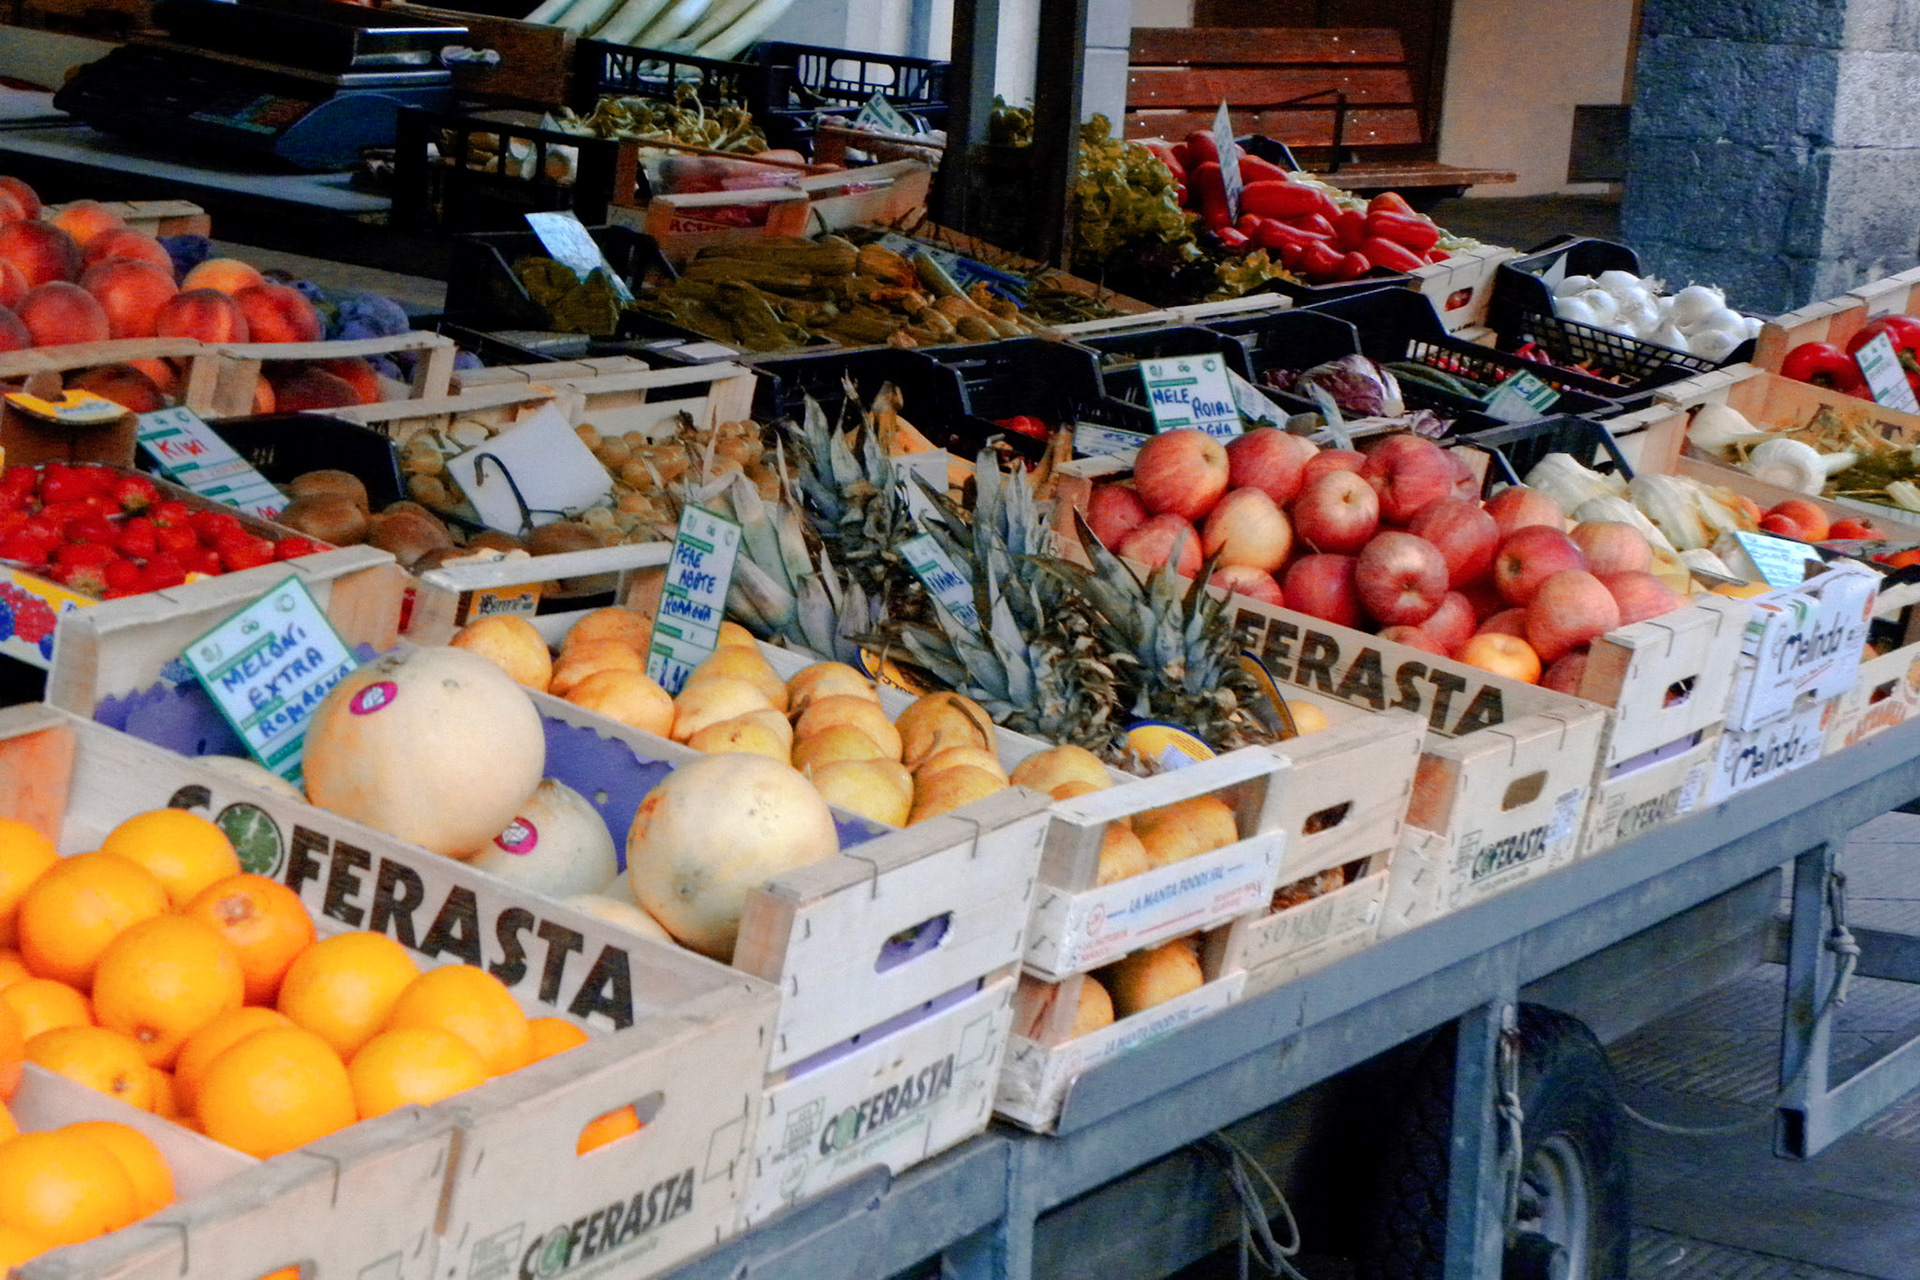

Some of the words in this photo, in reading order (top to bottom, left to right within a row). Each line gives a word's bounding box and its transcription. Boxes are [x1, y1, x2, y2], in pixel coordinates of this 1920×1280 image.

[1152, 387, 1191, 405] MELE
[150, 437, 210, 461] KIWI
[676, 541, 704, 569] PERE
[248, 647, 324, 712] EXTRA
